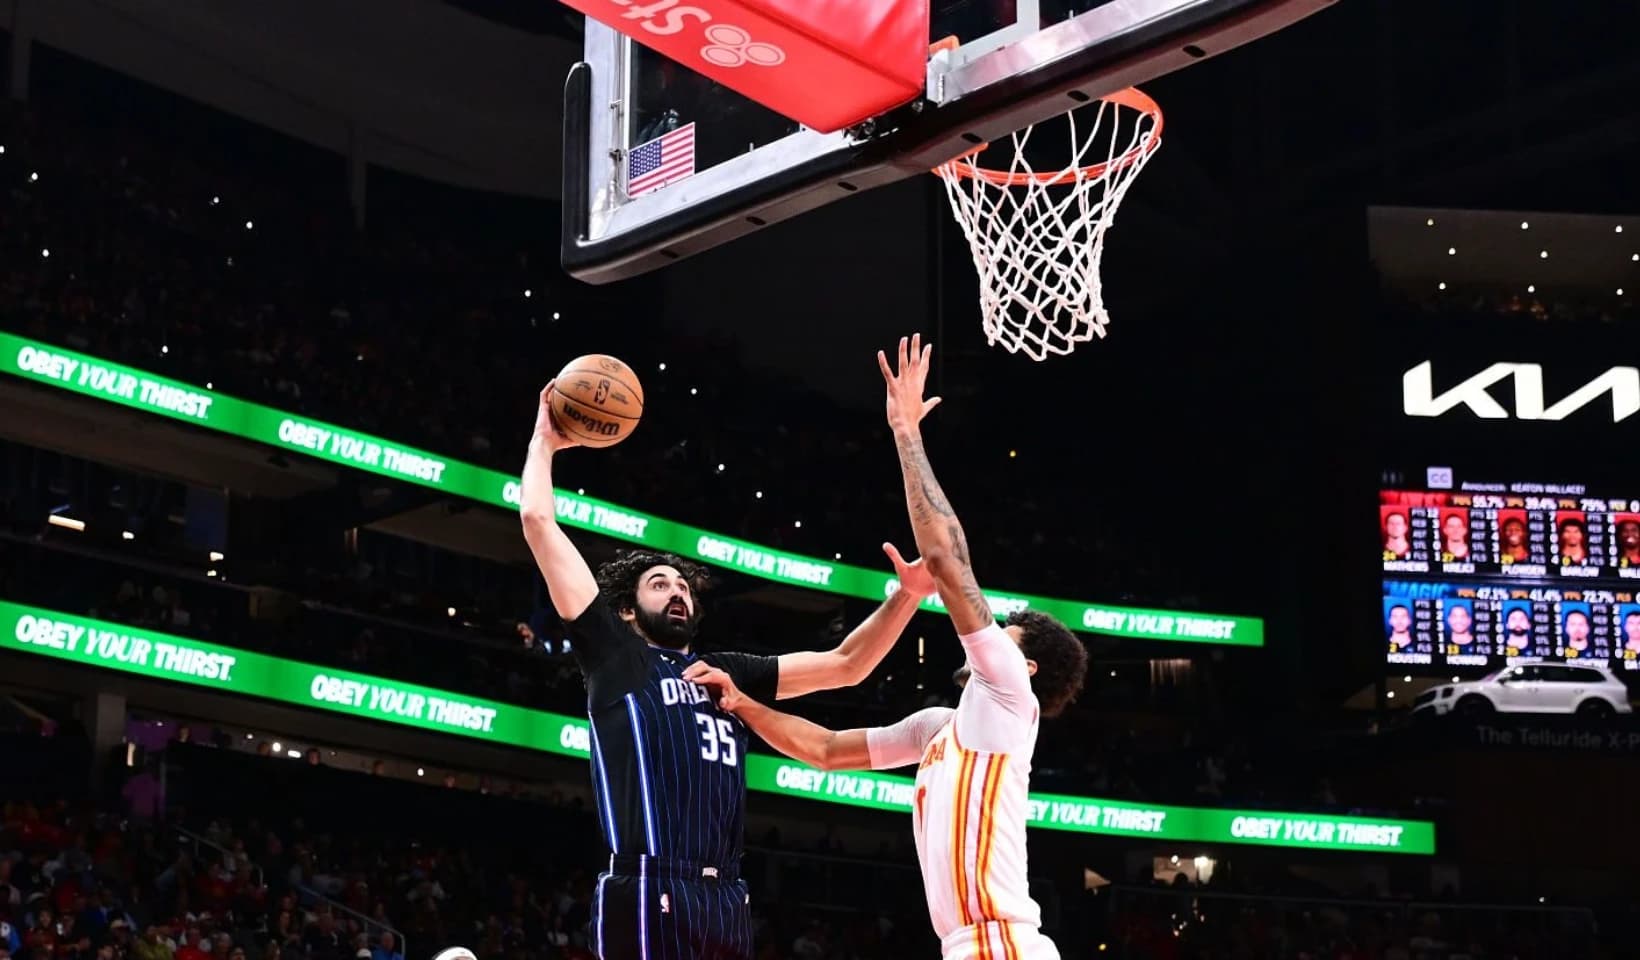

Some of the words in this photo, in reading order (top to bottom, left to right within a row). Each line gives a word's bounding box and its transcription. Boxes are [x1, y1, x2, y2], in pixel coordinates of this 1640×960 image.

[17, 346, 79, 382] OBEY
[78, 363, 138, 399] YOUR
[563, 401, 620, 435] Wilson
[279, 419, 331, 451] OBEY
[331, 433, 381, 465] YOUR
[1580, 498, 1606, 512] 75%
[593, 505, 648, 537] THIRST
[1608, 524, 1616, 534] 4
[1434, 530, 1440, 539] 1
[1491, 532, 1499, 540] 4
[1610, 535, 1615, 545] 1
[1433, 541, 1441, 550] 0
[698, 536, 738, 562] OBEY
[737, 547, 776, 573] YOUR
[778, 561, 832, 585] THIRST
[1435, 551, 1440, 561] 1
[1494, 553, 1499, 563] 1
[1551, 555, 1559, 564] 4
[1389, 582, 1449, 598] MAGIC
[1529, 589, 1562, 602] 41.4%
[1582, 590, 1614, 603] 72.7%
[1491, 602, 1503, 611] 14
[1613, 604, 1620, 614] 2
[1436, 612, 1443, 620] 2
[1496, 613, 1502, 622] 1
[1083, 609, 1128, 631] OBEY
[1128, 616, 1174, 635] YOUR
[1176, 618, 1236, 639] THIRST
[15, 615, 84, 651] OBEY
[85, 628, 151, 665] YOUR
[1438, 633, 1444, 642] 1
[1557, 636, 1562, 645] 1
[1439, 644, 1445, 653] 1
[1496, 645, 1505, 655] 2
[311, 674, 370, 707] OBEY
[370, 686, 425, 719] YOUR
[695, 712, 737, 767] 35
[1477, 724, 1512, 745] The
[1519, 728, 1601, 749] Telluride
[776, 766, 827, 793] OBEY
[826, 774, 875, 800] YOUR
[1050, 801, 1100, 827] YOUR
[1102, 806, 1166, 832] THIRST
[1231, 816, 1283, 839] OBEY
[1284, 820, 1335, 842] YOUR
[1336, 823, 1403, 846] THIRST
